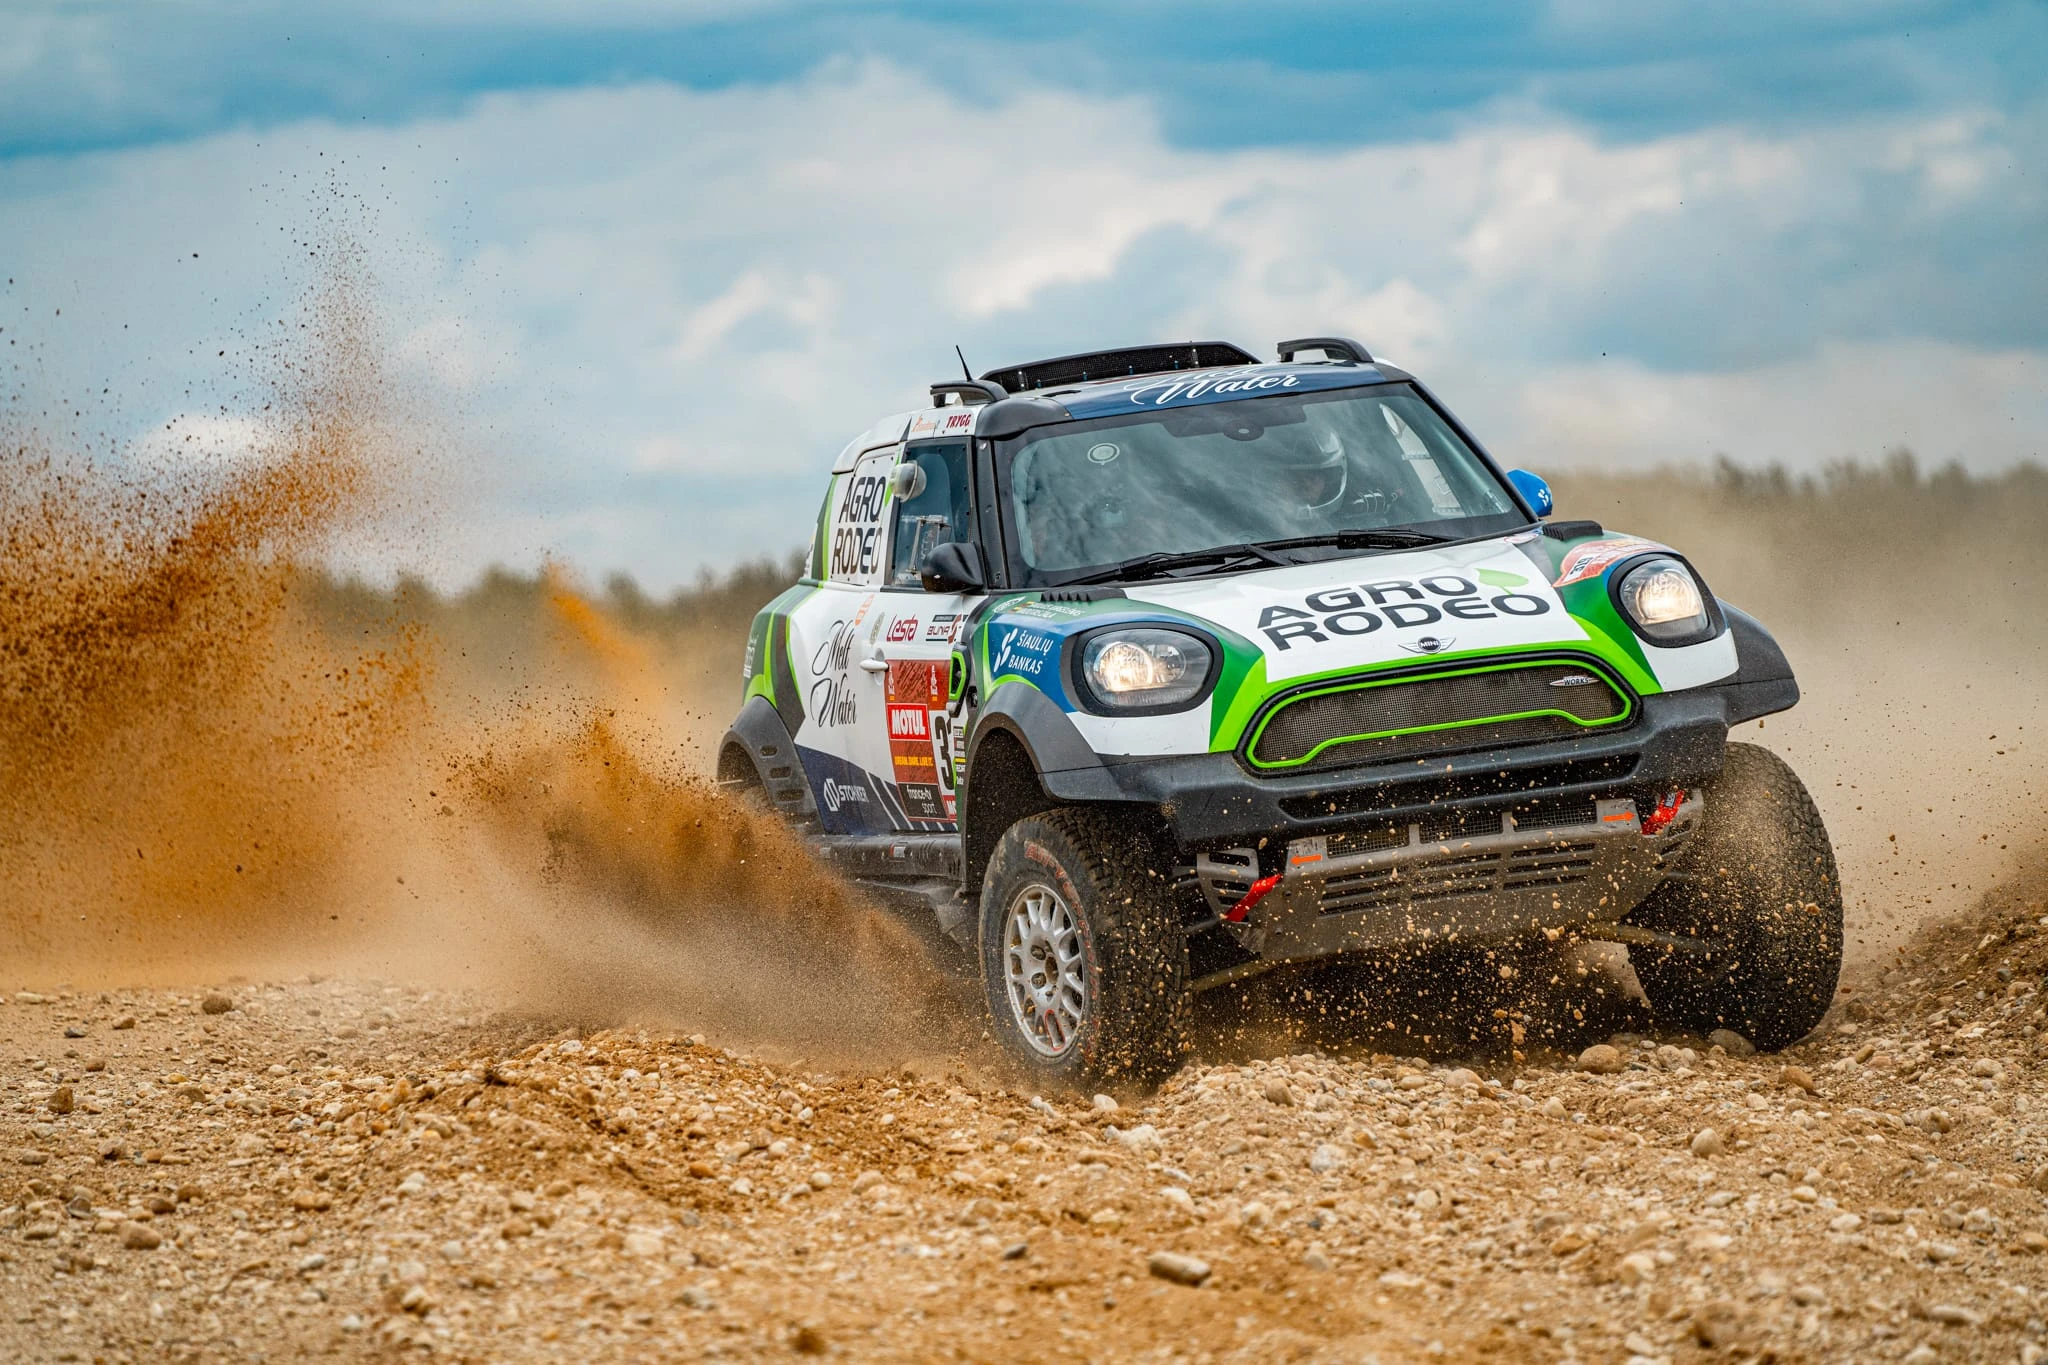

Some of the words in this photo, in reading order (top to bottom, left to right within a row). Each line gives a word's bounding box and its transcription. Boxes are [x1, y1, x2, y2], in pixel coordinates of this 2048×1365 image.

[1130, 371, 1300, 405] Water
[839, 476, 886, 524] AGRO
[832, 527, 883, 574] RODEO
[1257, 575, 1478, 629] AGRO
[1016, 629, 1054, 656] ŠIAULIŲ
[1262, 594, 1551, 651] RODEO
[812, 619, 855, 676] Melt
[1420, 640, 1439, 648] MINI
[1008, 654, 1043, 675] BANKAS
[1563, 678, 1589, 686] WORKS
[810, 672, 857, 728] Water
[891, 709, 926, 736] MOTUL
